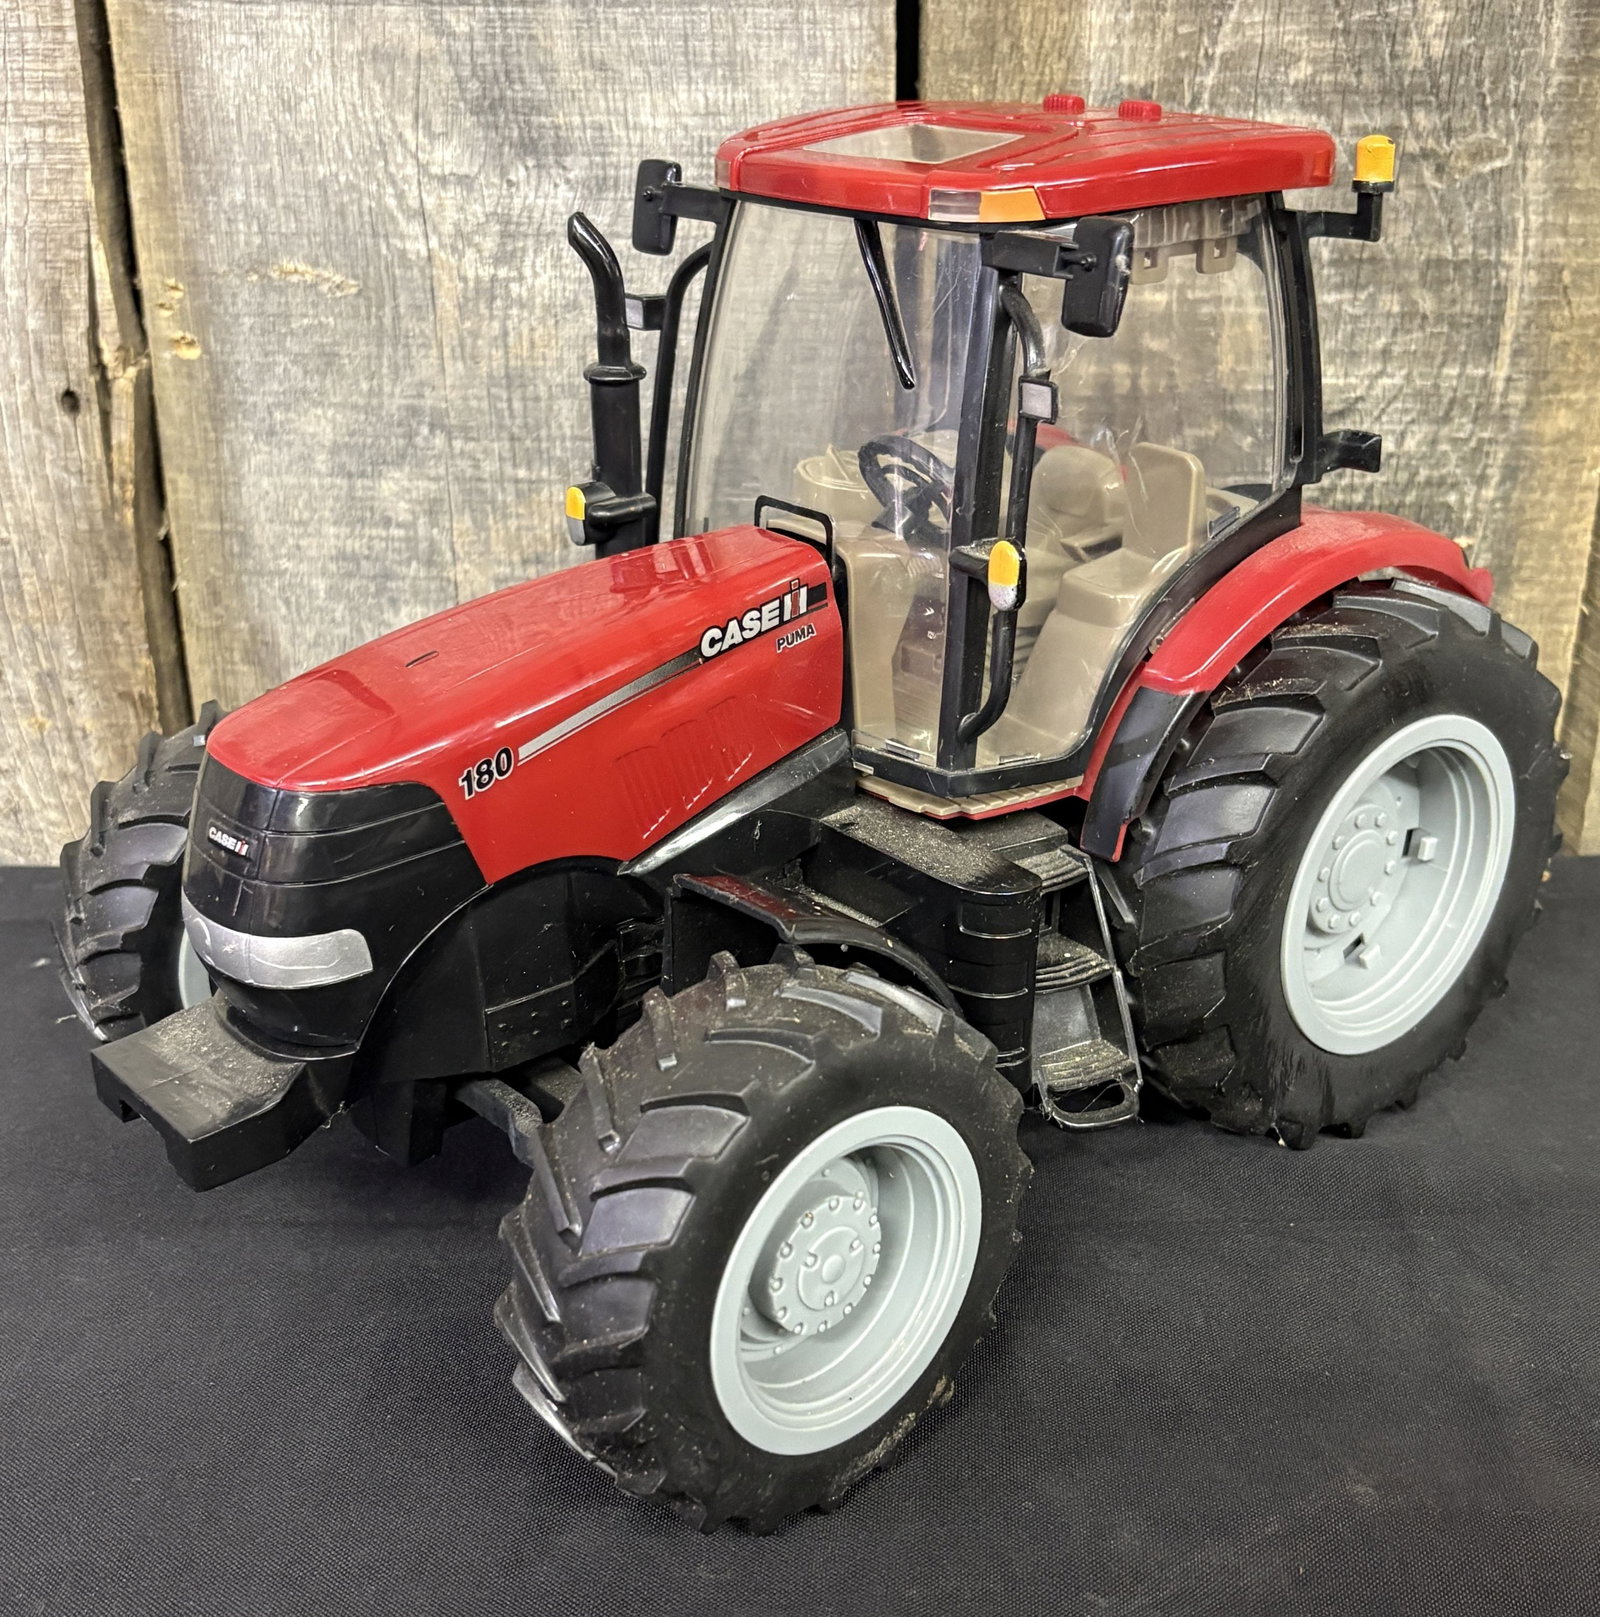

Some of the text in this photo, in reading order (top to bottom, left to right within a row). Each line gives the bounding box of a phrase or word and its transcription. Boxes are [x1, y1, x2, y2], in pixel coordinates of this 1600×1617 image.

[700, 598, 780, 658] CASE
[776, 623, 816, 653] PUMA
[458, 746, 514, 800] 180
[209, 826, 237, 850] CASE
